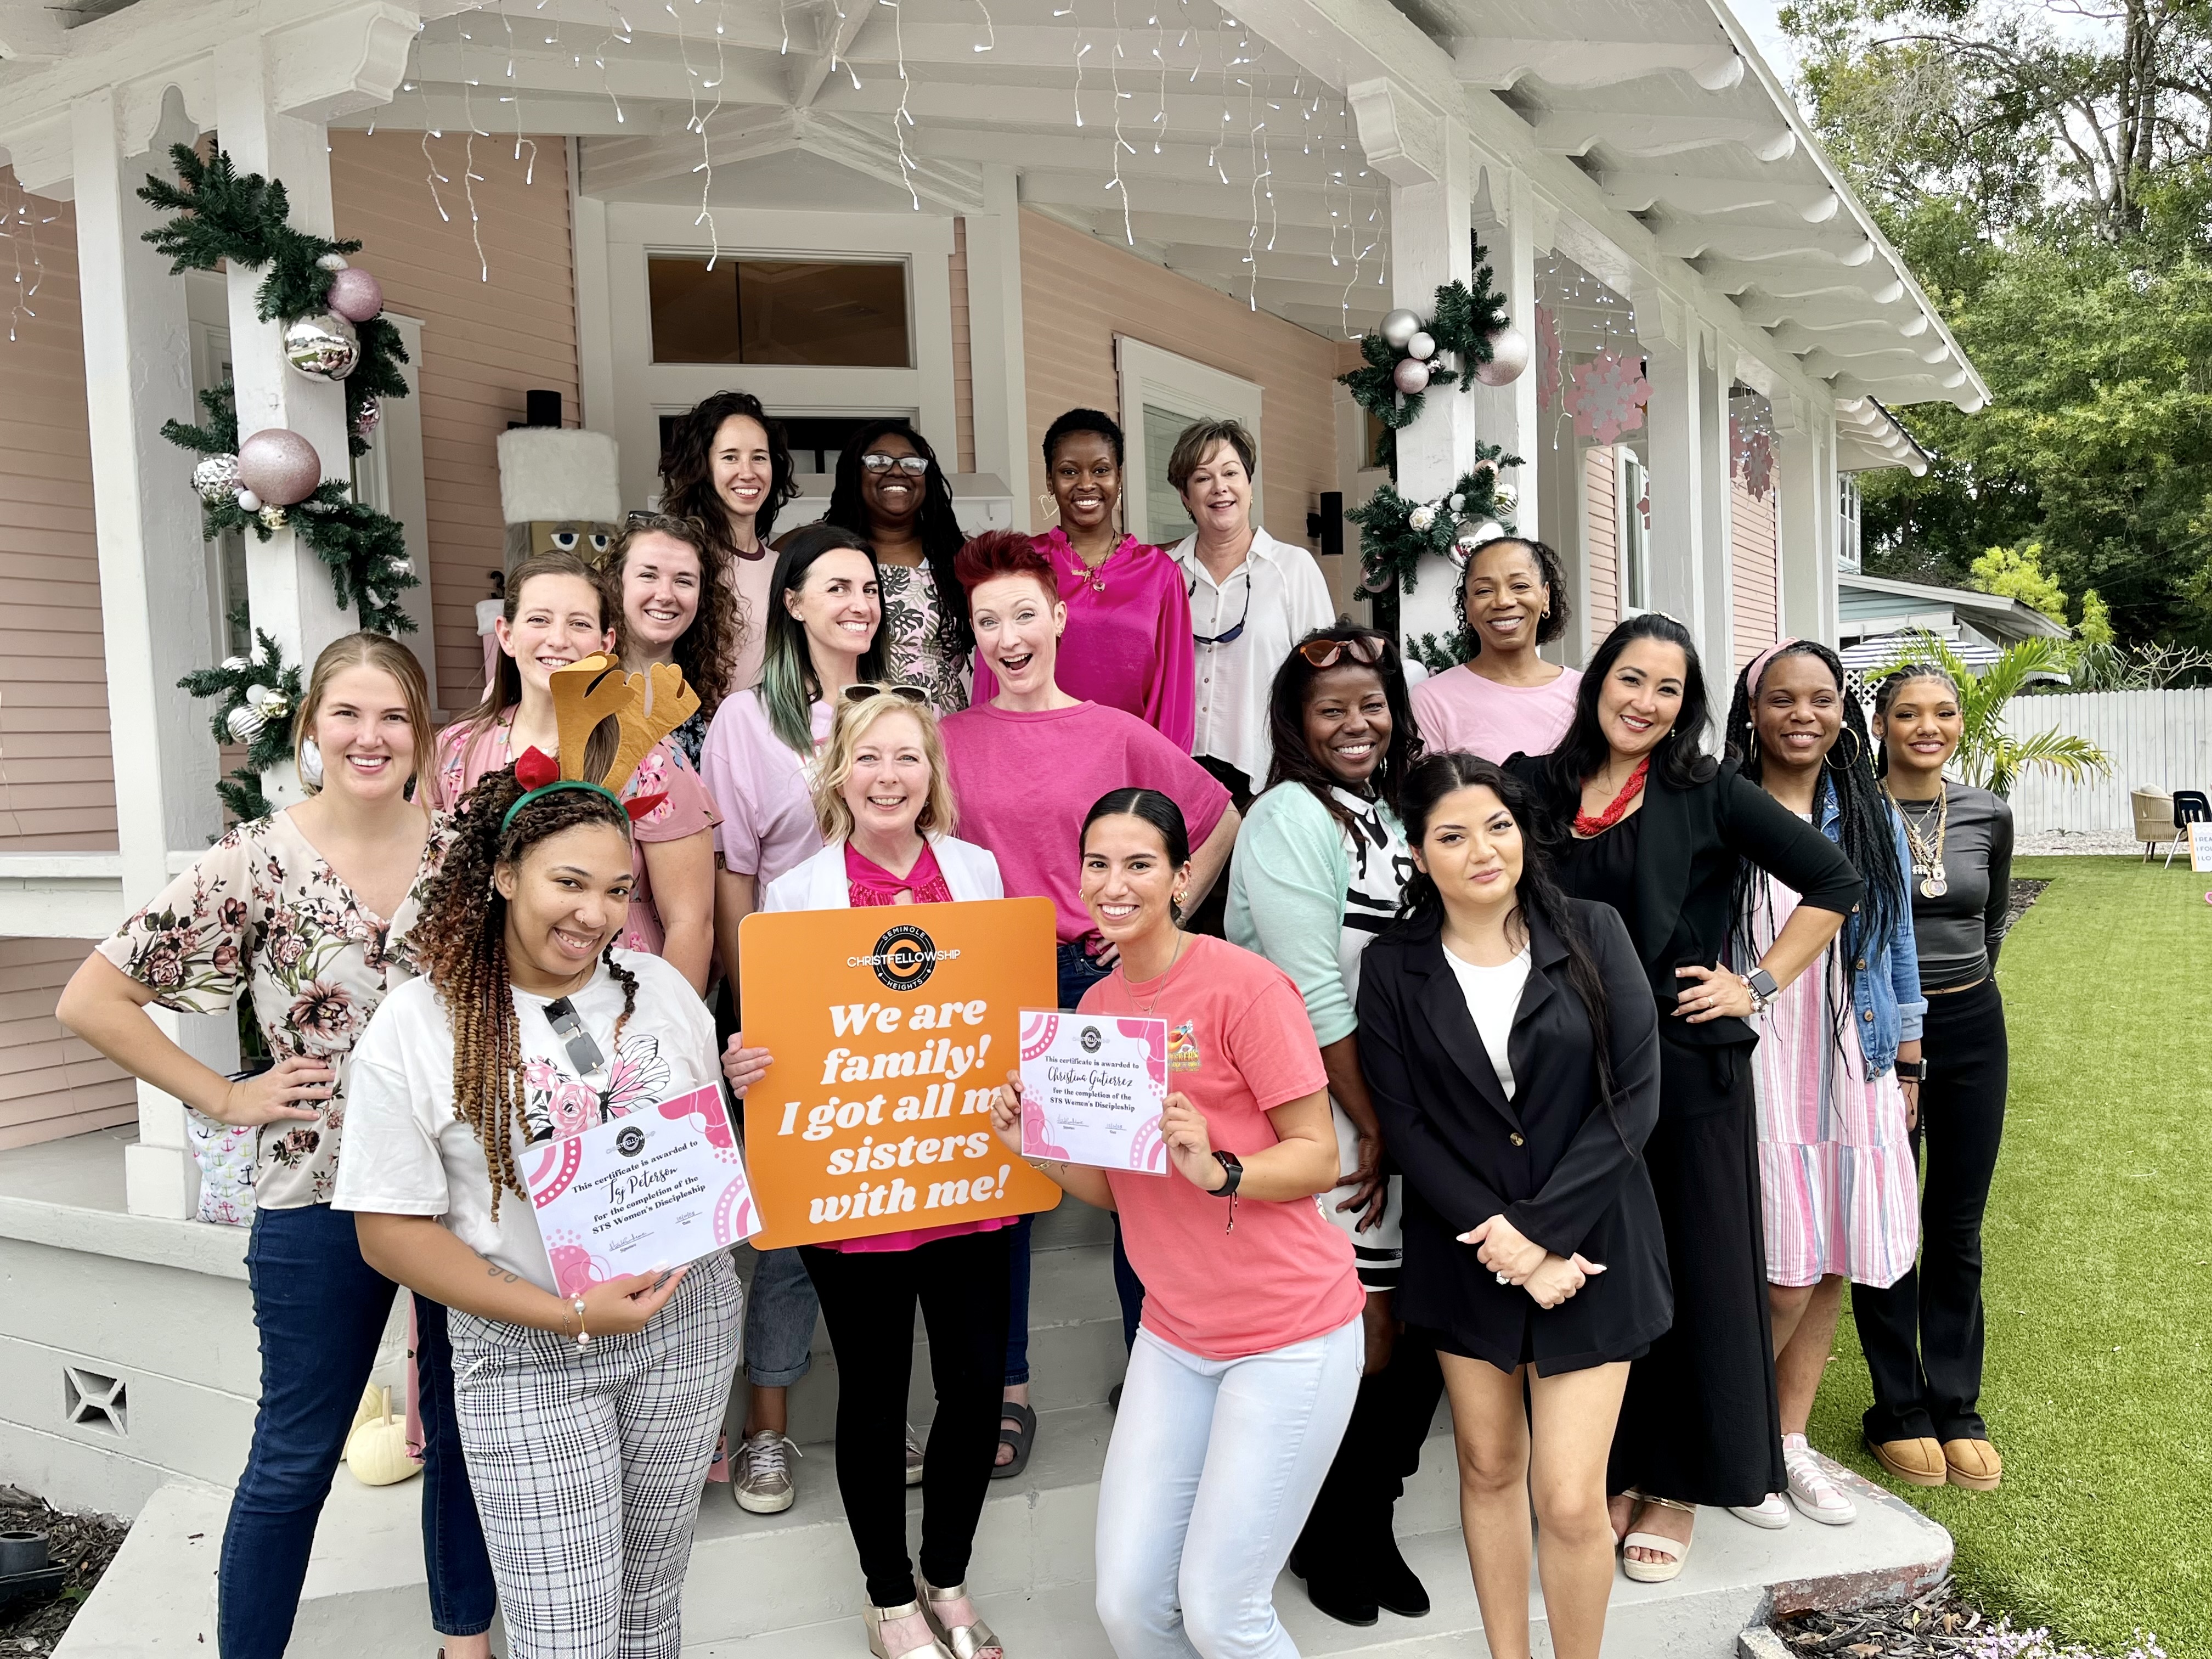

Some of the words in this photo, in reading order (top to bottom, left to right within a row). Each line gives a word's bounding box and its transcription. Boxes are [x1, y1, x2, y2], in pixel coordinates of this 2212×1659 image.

[882, 926, 926, 941] SEMINOLE
[847, 949, 961, 967] CHRISTFELLOWSHIP
[887, 978, 923, 990] HEIGHTS
[829, 1002, 901, 1037] We
[909, 1000, 987, 1030] are
[820, 1034, 991, 1085] family!
[1048, 1066, 1087, 1084] Christina
[1089, 1070, 1133, 1091] Gutierrez
[1075, 1091, 1110, 1099] completion
[777, 1102, 801, 1136] I
[802, 1094, 887, 1141] got
[892, 1082, 956, 1122] all
[960, 1086, 1003, 1115] m
[1064, 1098, 1093, 1107] Women's
[1095, 1101, 1135, 1113] Discipleship
[572, 1182, 592, 1194] This
[594, 1164, 640, 1186] certificate
[651, 1143, 688, 1163] awarded
[690, 1141, 698, 1149] to
[826, 1132, 990, 1175] sisters
[594, 1212, 608, 1222] for
[610, 1205, 625, 1215] the
[626, 1186, 672, 1209] completion
[674, 1180, 683, 1189] of
[685, 1176, 698, 1185] the
[601, 1178, 626, 1204] Taj
[627, 1167, 678, 1194] Peterson
[809, 1178, 916, 1224] with
[923, 1164, 1011, 1209] me!
[592, 1222, 611, 1234] STS
[613, 1206, 653, 1225] Women's
[654, 1184, 706, 1209] Discipleship
